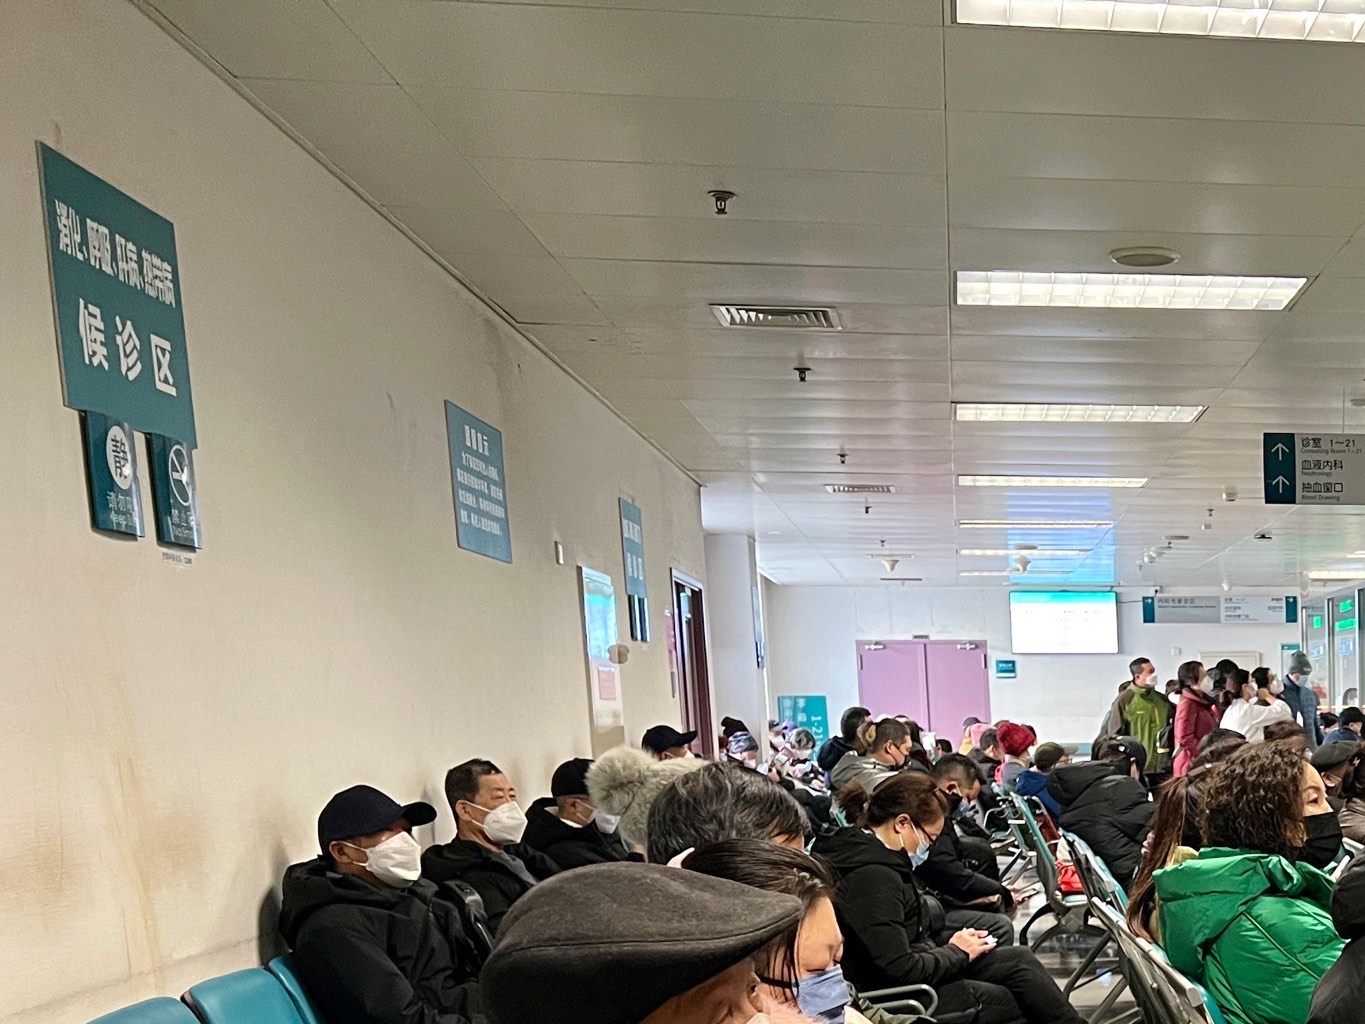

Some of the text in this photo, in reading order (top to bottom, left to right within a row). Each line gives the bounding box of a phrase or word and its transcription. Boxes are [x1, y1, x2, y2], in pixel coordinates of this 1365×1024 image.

[79, 297, 177, 397] 候诊区
[1302, 438, 1321, 448] 诊室
[1302, 460, 1343, 470] 血液内科
[1302, 482, 1343, 493] 抽血窗口
